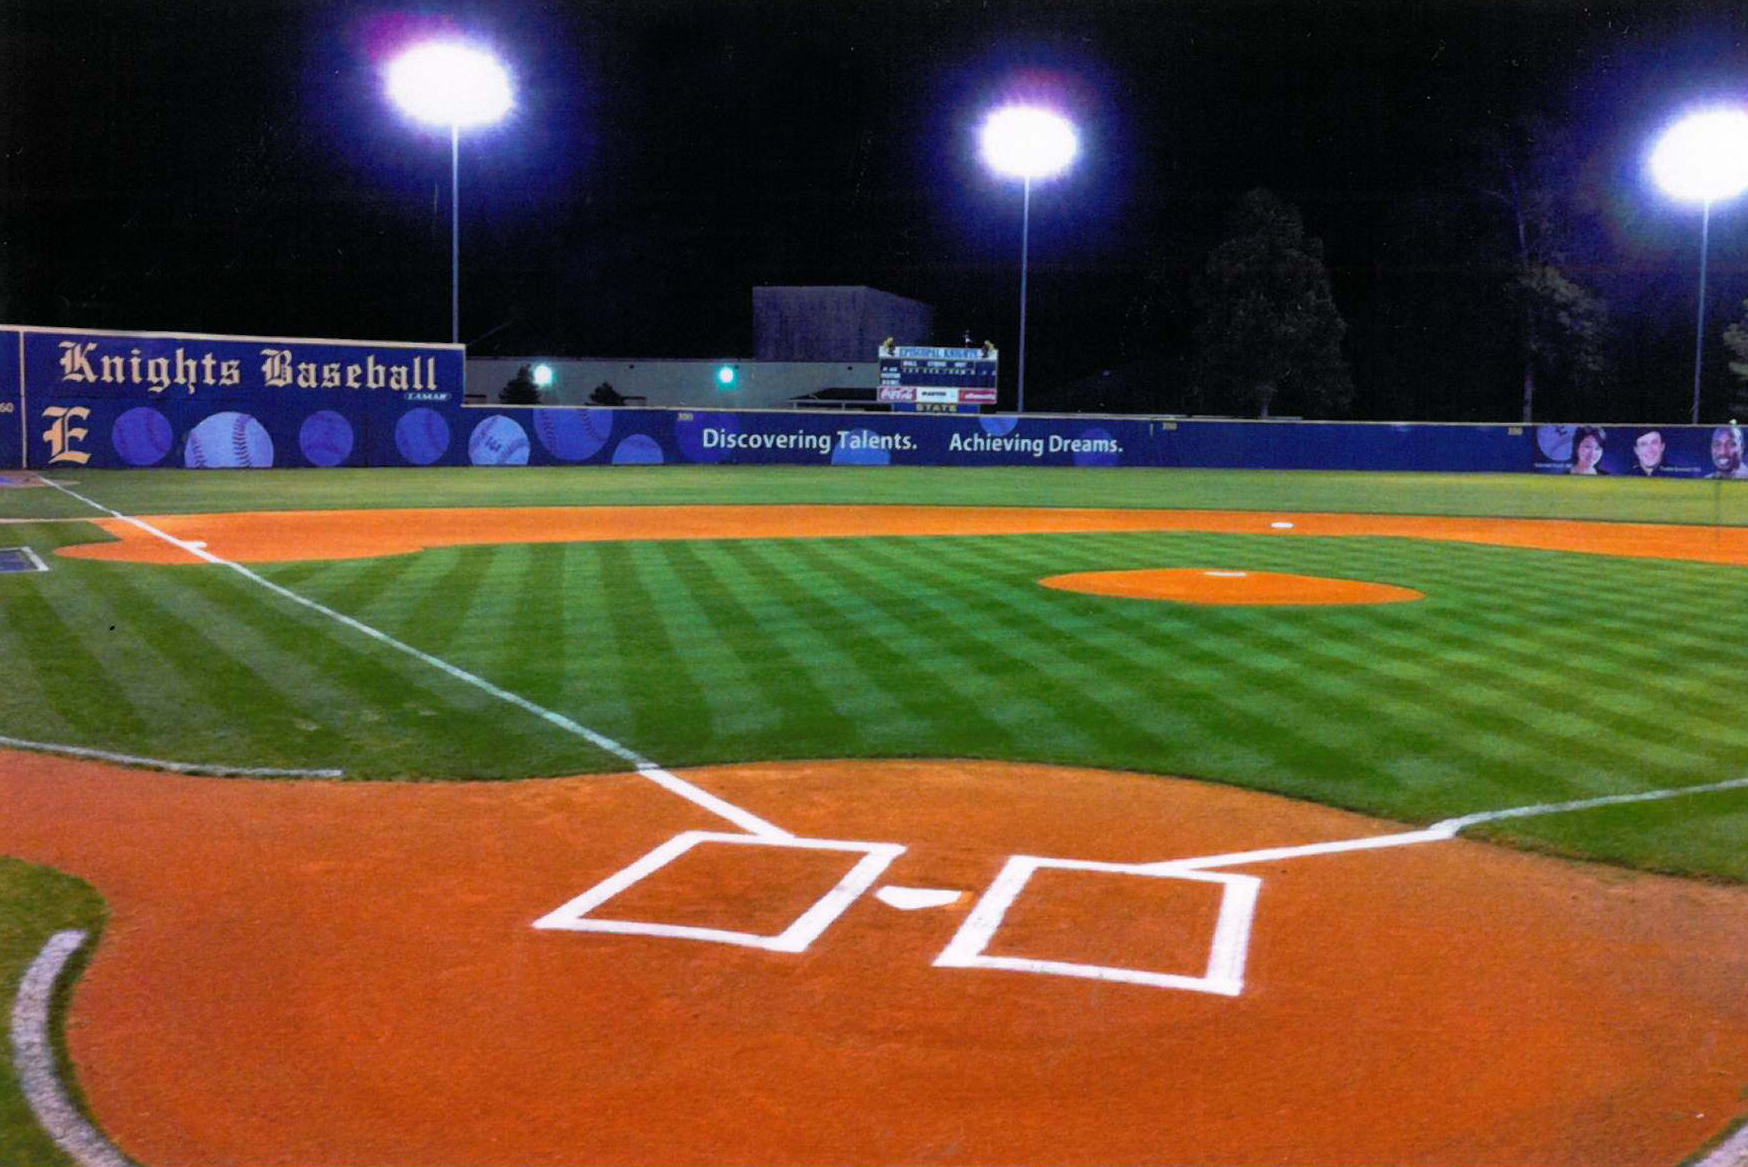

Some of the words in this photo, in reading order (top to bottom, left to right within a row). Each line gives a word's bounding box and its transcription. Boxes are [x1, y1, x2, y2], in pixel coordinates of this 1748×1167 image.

[59, 341, 241, 393] Knights
[261, 349, 438, 391] Baseball
[917, 403, 957, 412] STATE
[42, 406, 91, 464] E
[703, 428, 831, 457] Discovering
[837, 431, 918, 450] Talents.
[948, 432, 1045, 458] Achieving
[1049, 435, 1123, 454] Dreams.
